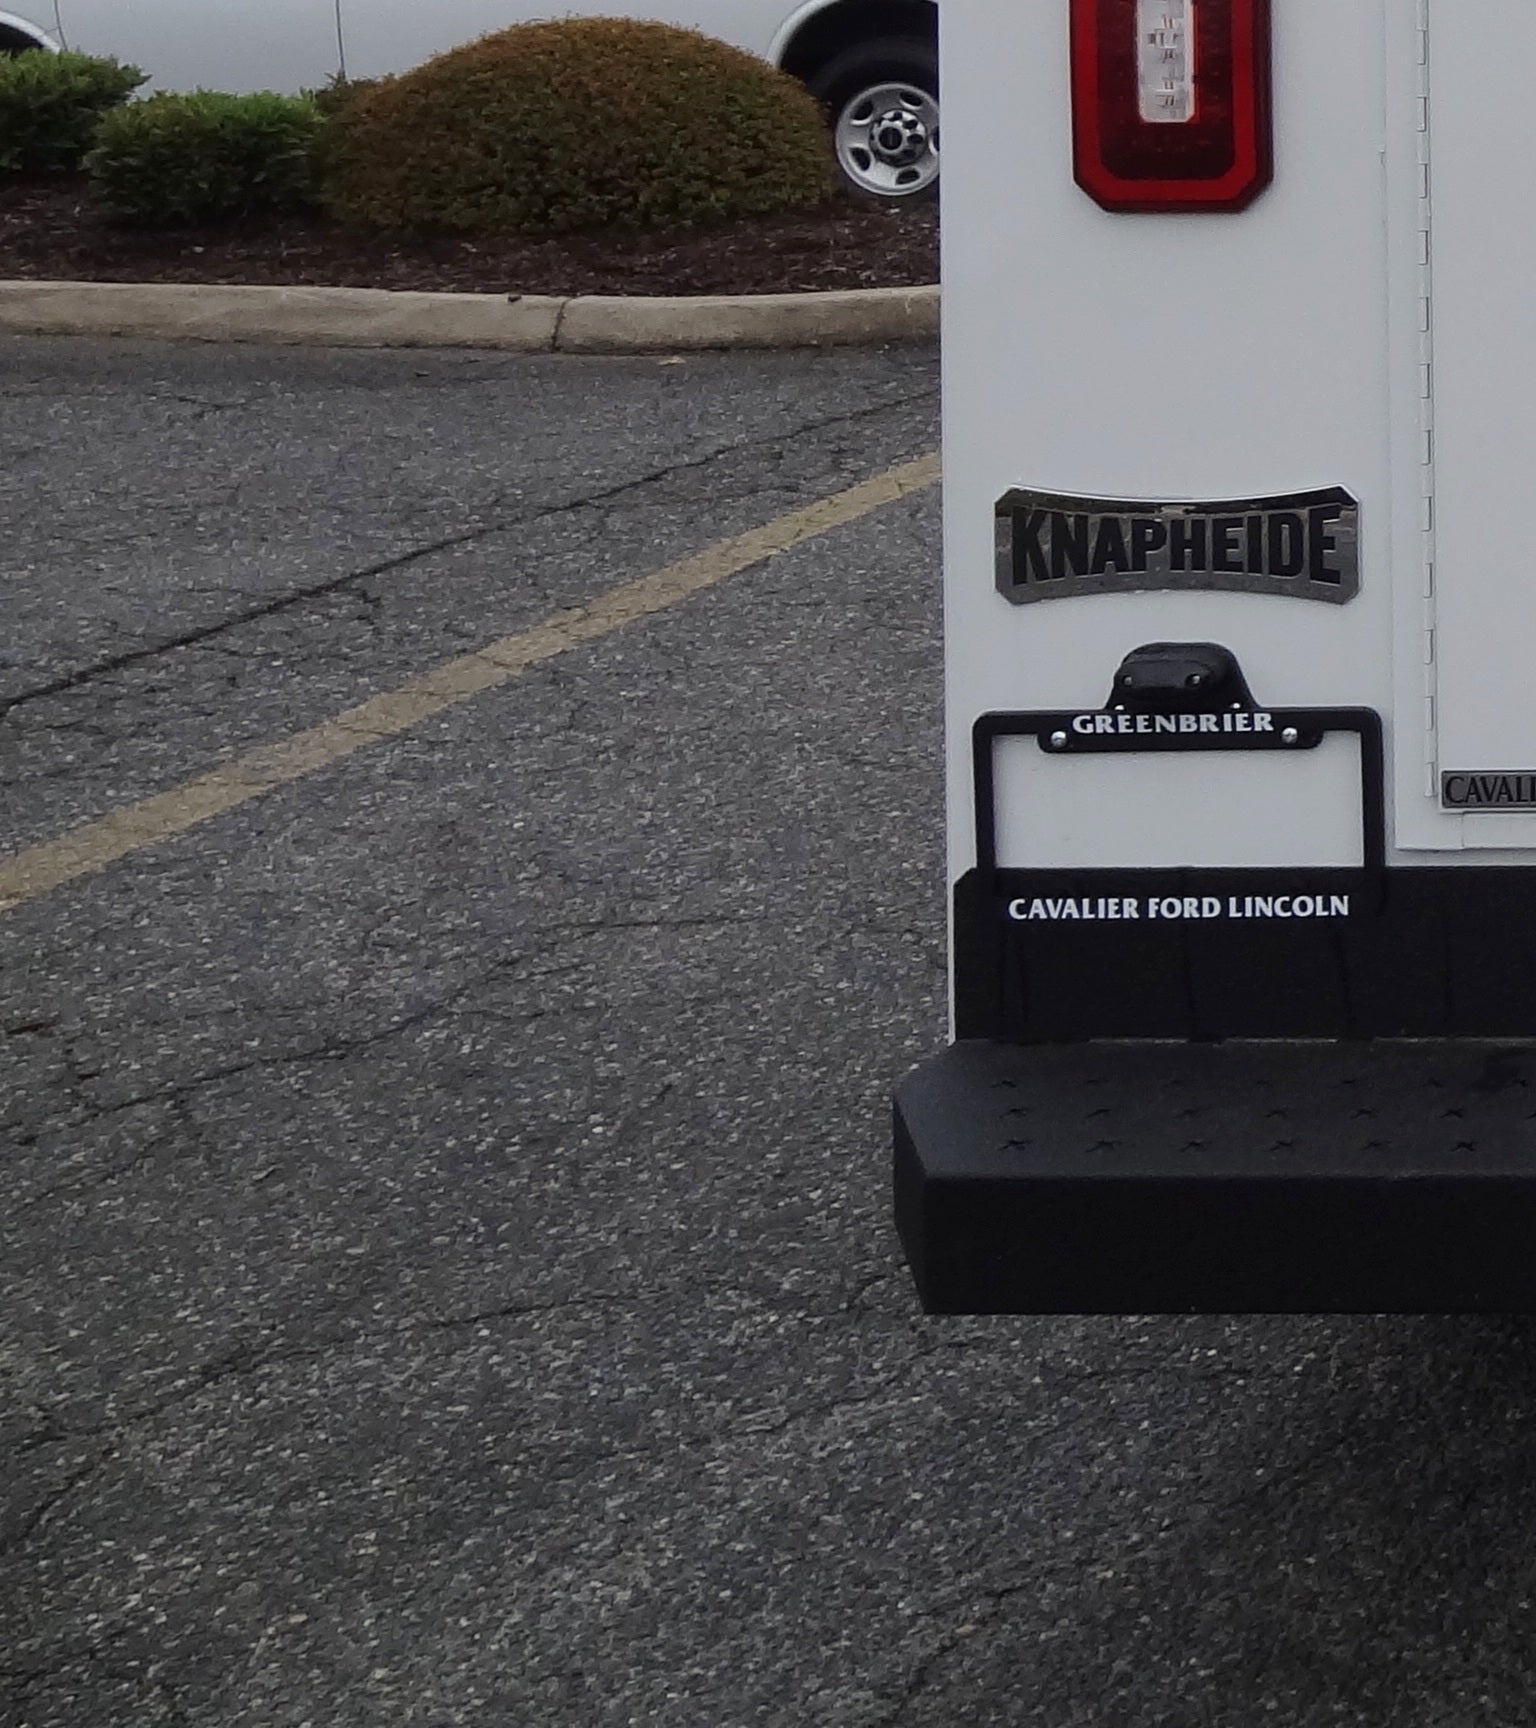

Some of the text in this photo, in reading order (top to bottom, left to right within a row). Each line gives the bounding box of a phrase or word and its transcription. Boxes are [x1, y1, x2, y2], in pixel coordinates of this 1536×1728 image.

[1012, 505, 1342, 585] KNAPHEIDE
[1072, 713, 1274, 734] GREENBRIER
[1009, 895, 1349, 920] CAVALIER FORD LINCOLN
